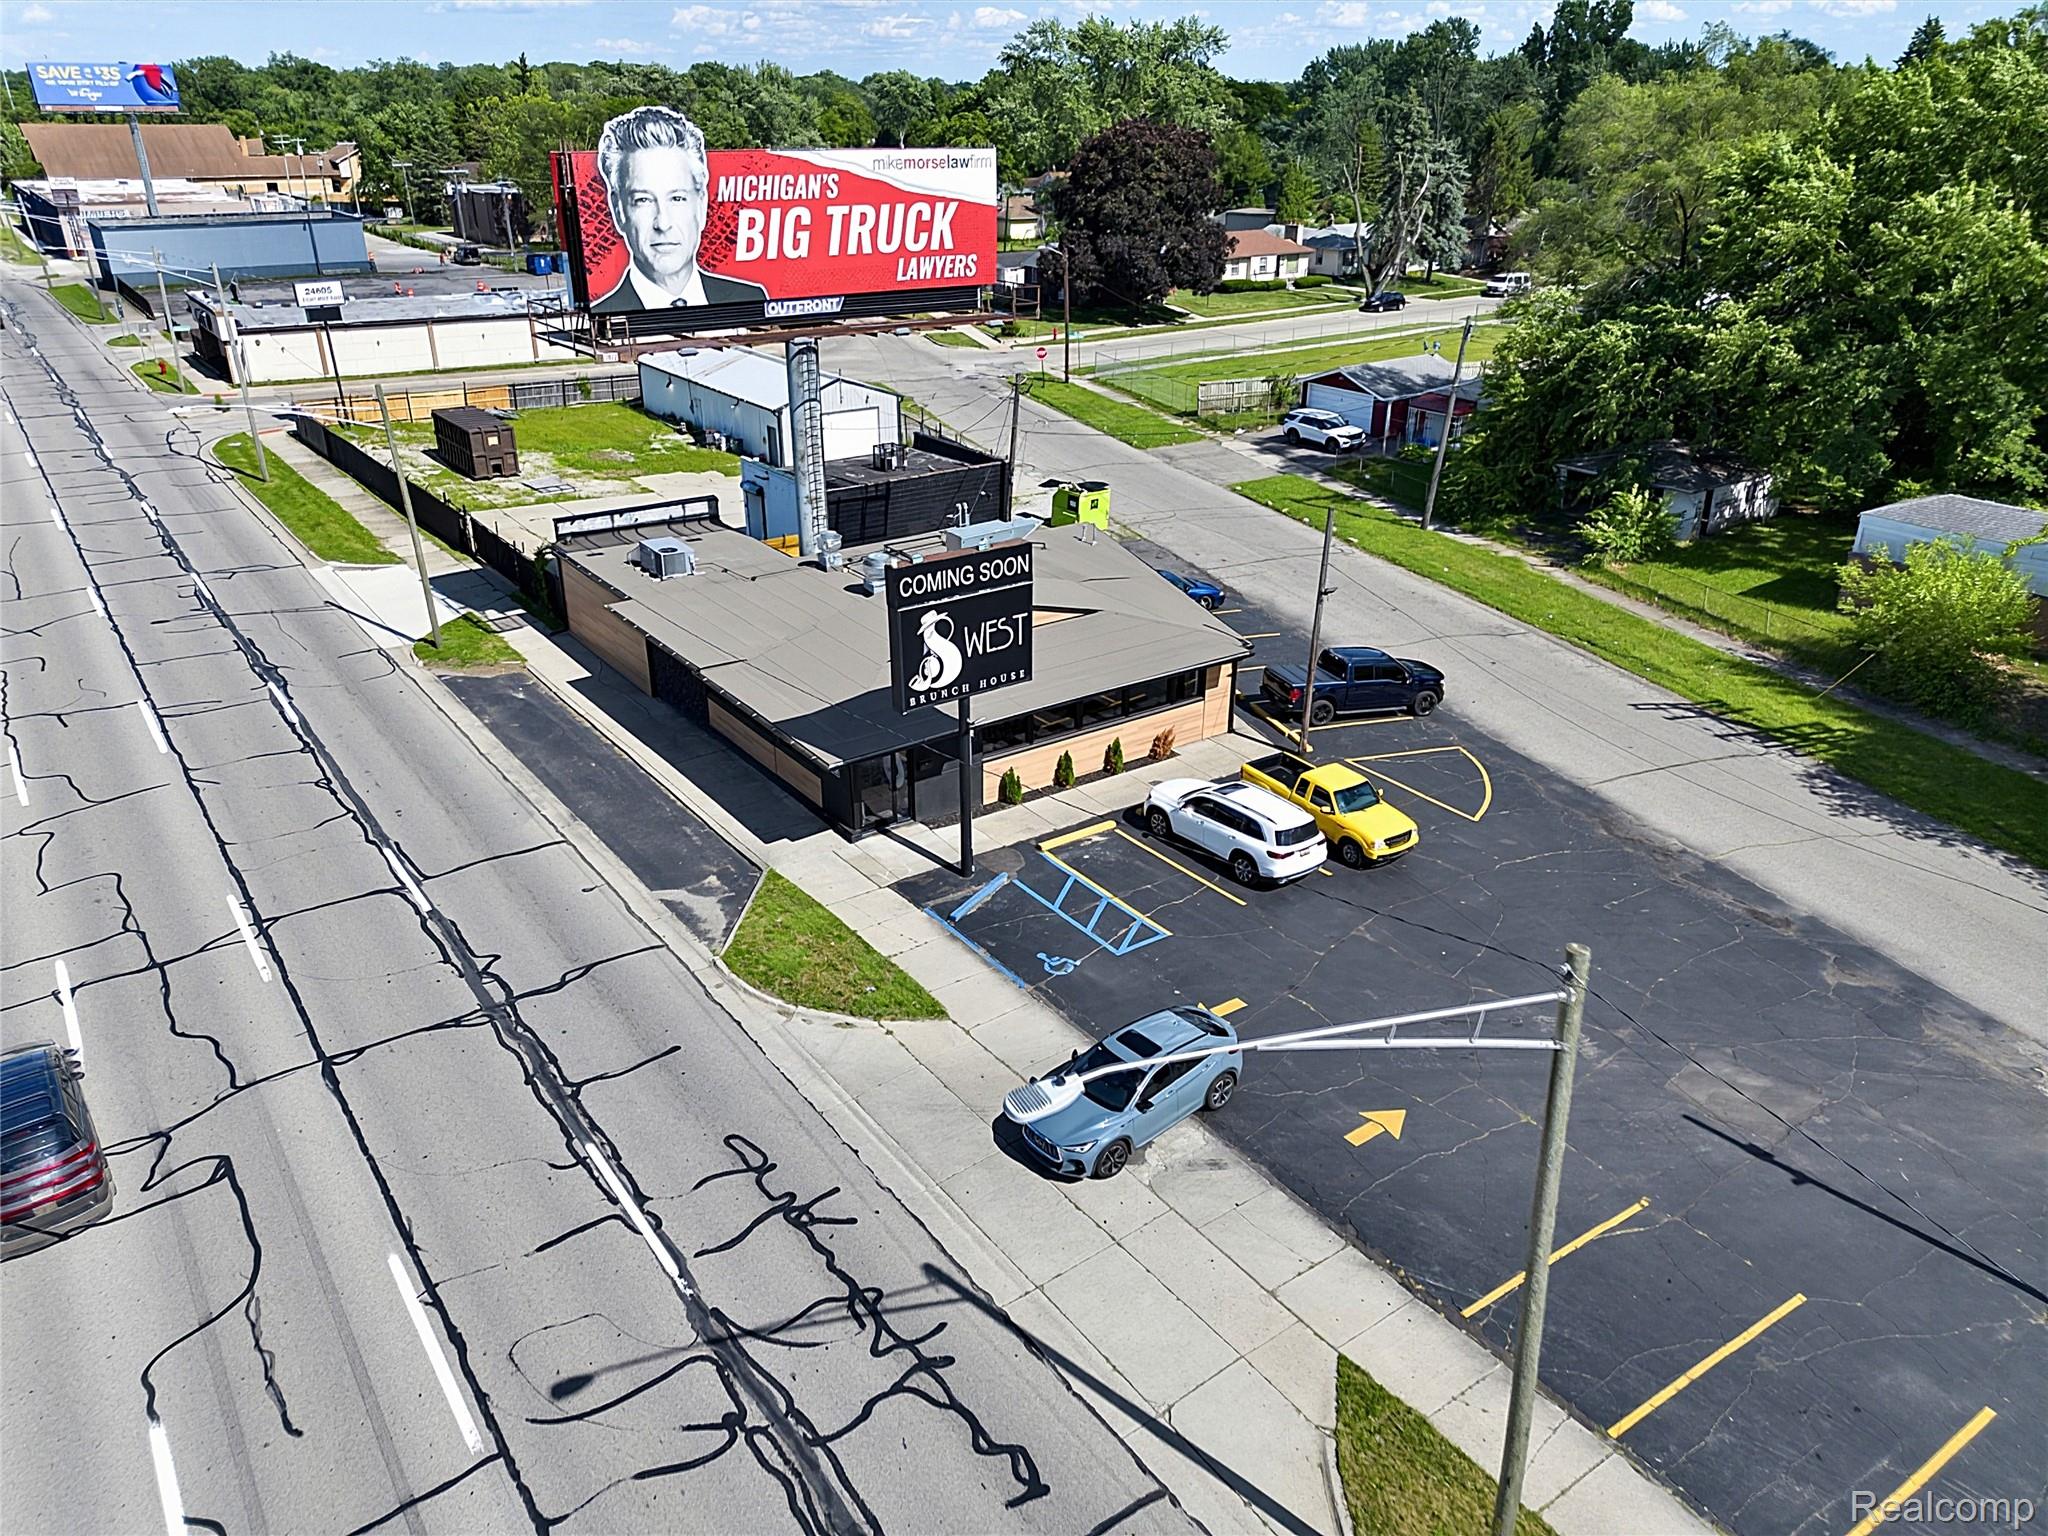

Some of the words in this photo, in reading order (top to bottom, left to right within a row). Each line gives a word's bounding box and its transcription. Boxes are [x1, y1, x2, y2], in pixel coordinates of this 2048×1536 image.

[36, 65, 81, 79] SAVE
[872, 154, 992, 171] mikemorselawfirm
[717, 173, 839, 201] MICHIGAN'S
[735, 206, 811, 262] BIG
[826, 201, 959, 256] TRUCK
[896, 254, 977, 281] LAWYERS
[767, 297, 840, 315] OUTFRONT
[899, 565, 974, 598] COMING
[979, 553, 1029, 582] SOON
[964, 612, 1028, 657] WEST
[909, 684, 970, 706] BRUNCH
[979, 669, 1025, 689] HOUSE
